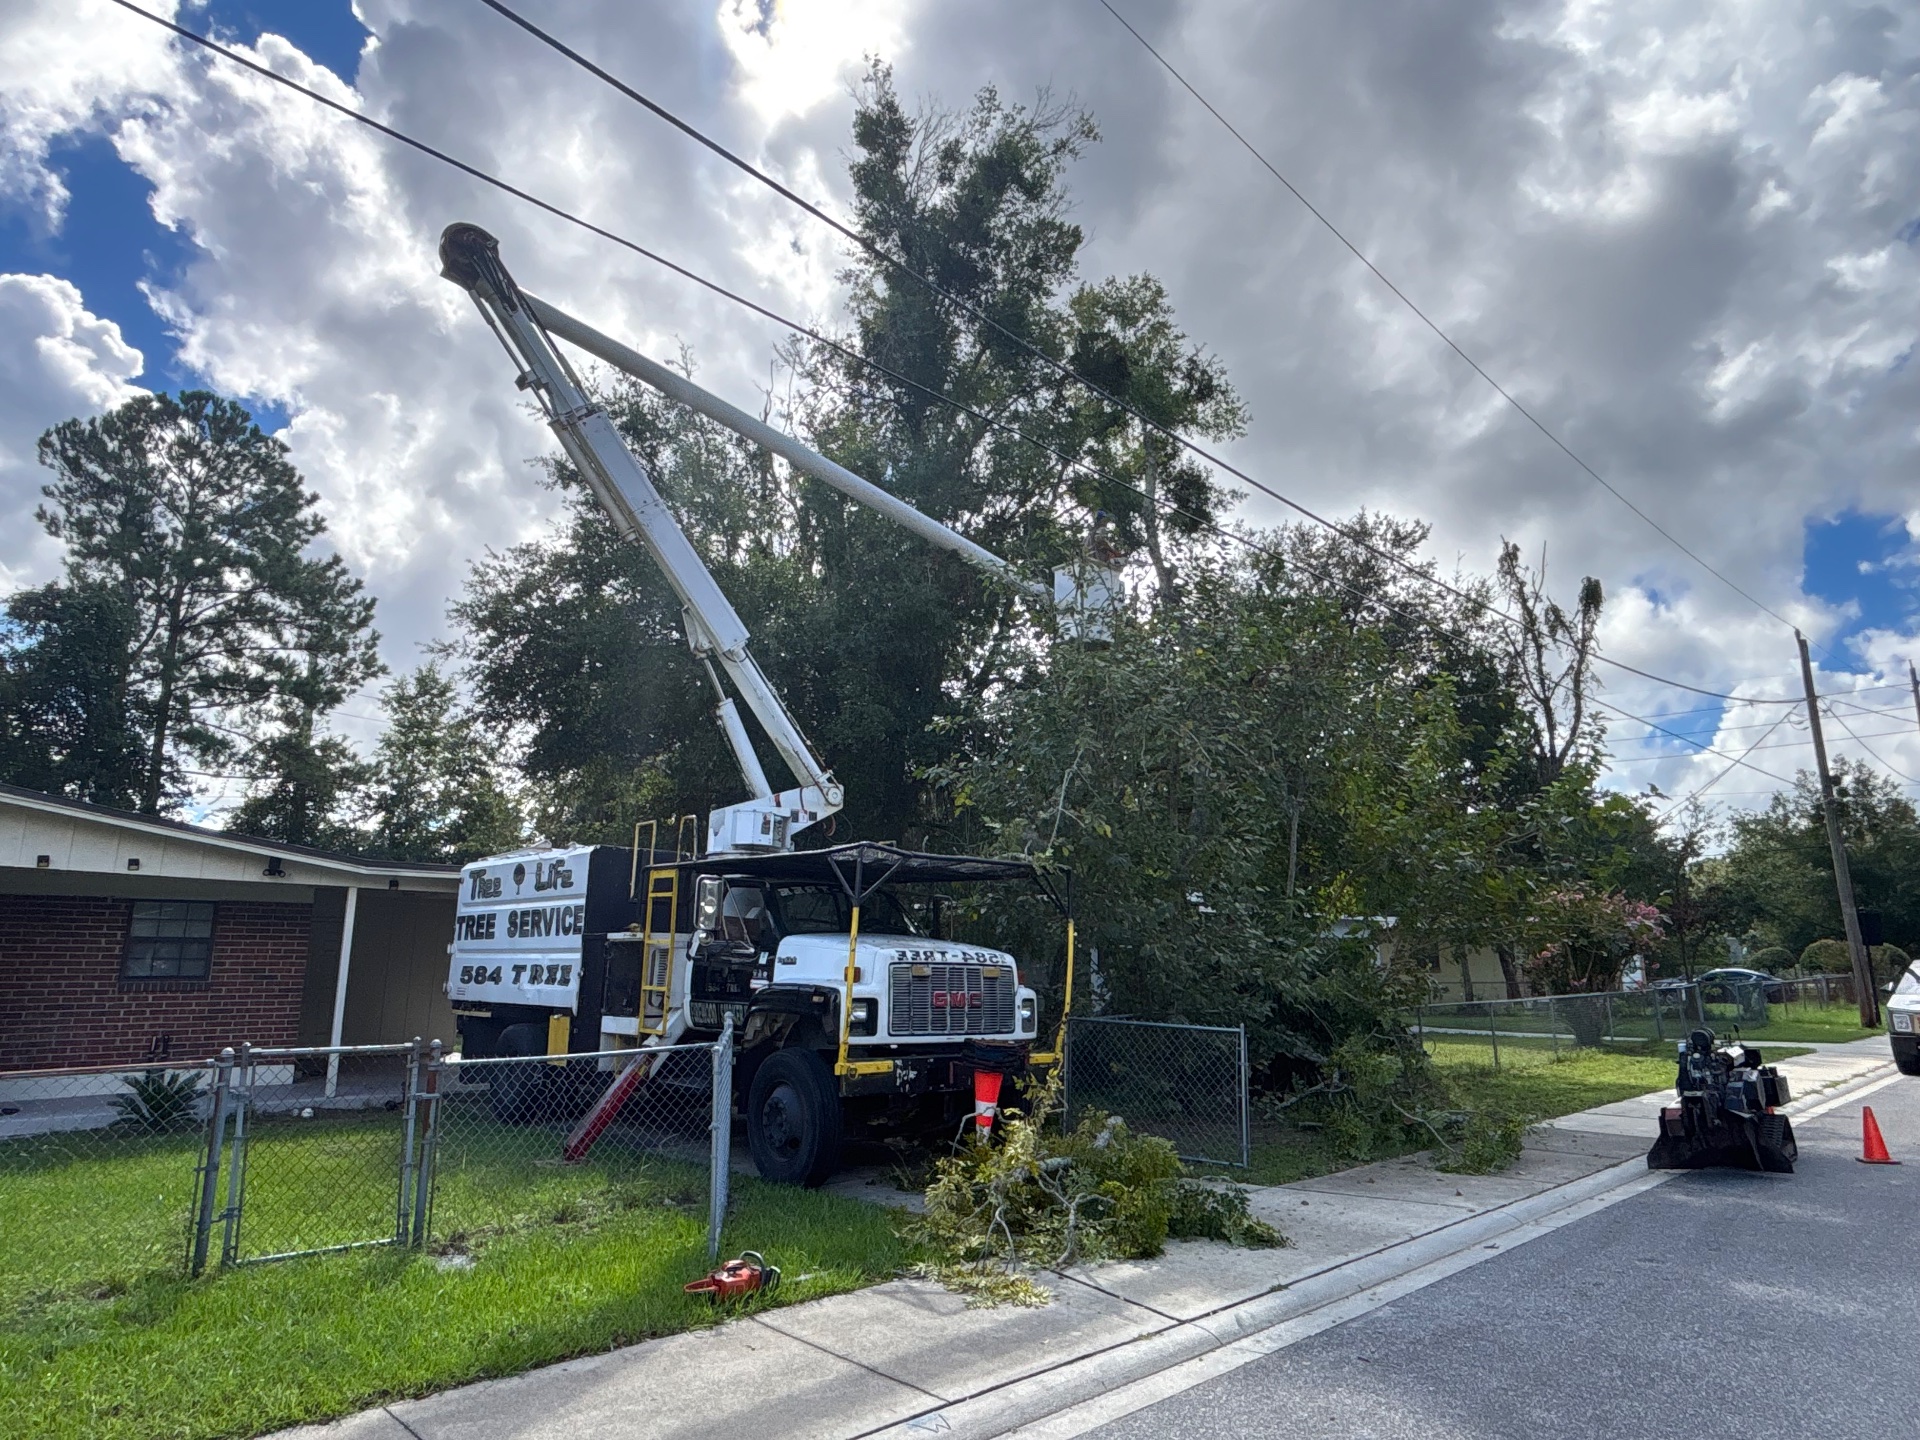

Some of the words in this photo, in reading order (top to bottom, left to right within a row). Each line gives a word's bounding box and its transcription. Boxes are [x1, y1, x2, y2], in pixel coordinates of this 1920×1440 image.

[457, 912, 497, 941] TREE
[507, 905, 584, 939] SERVICE
[459, 965, 502, 985] 584
[512, 963, 573, 987] TREE
[933, 990, 982, 1007] GMC
